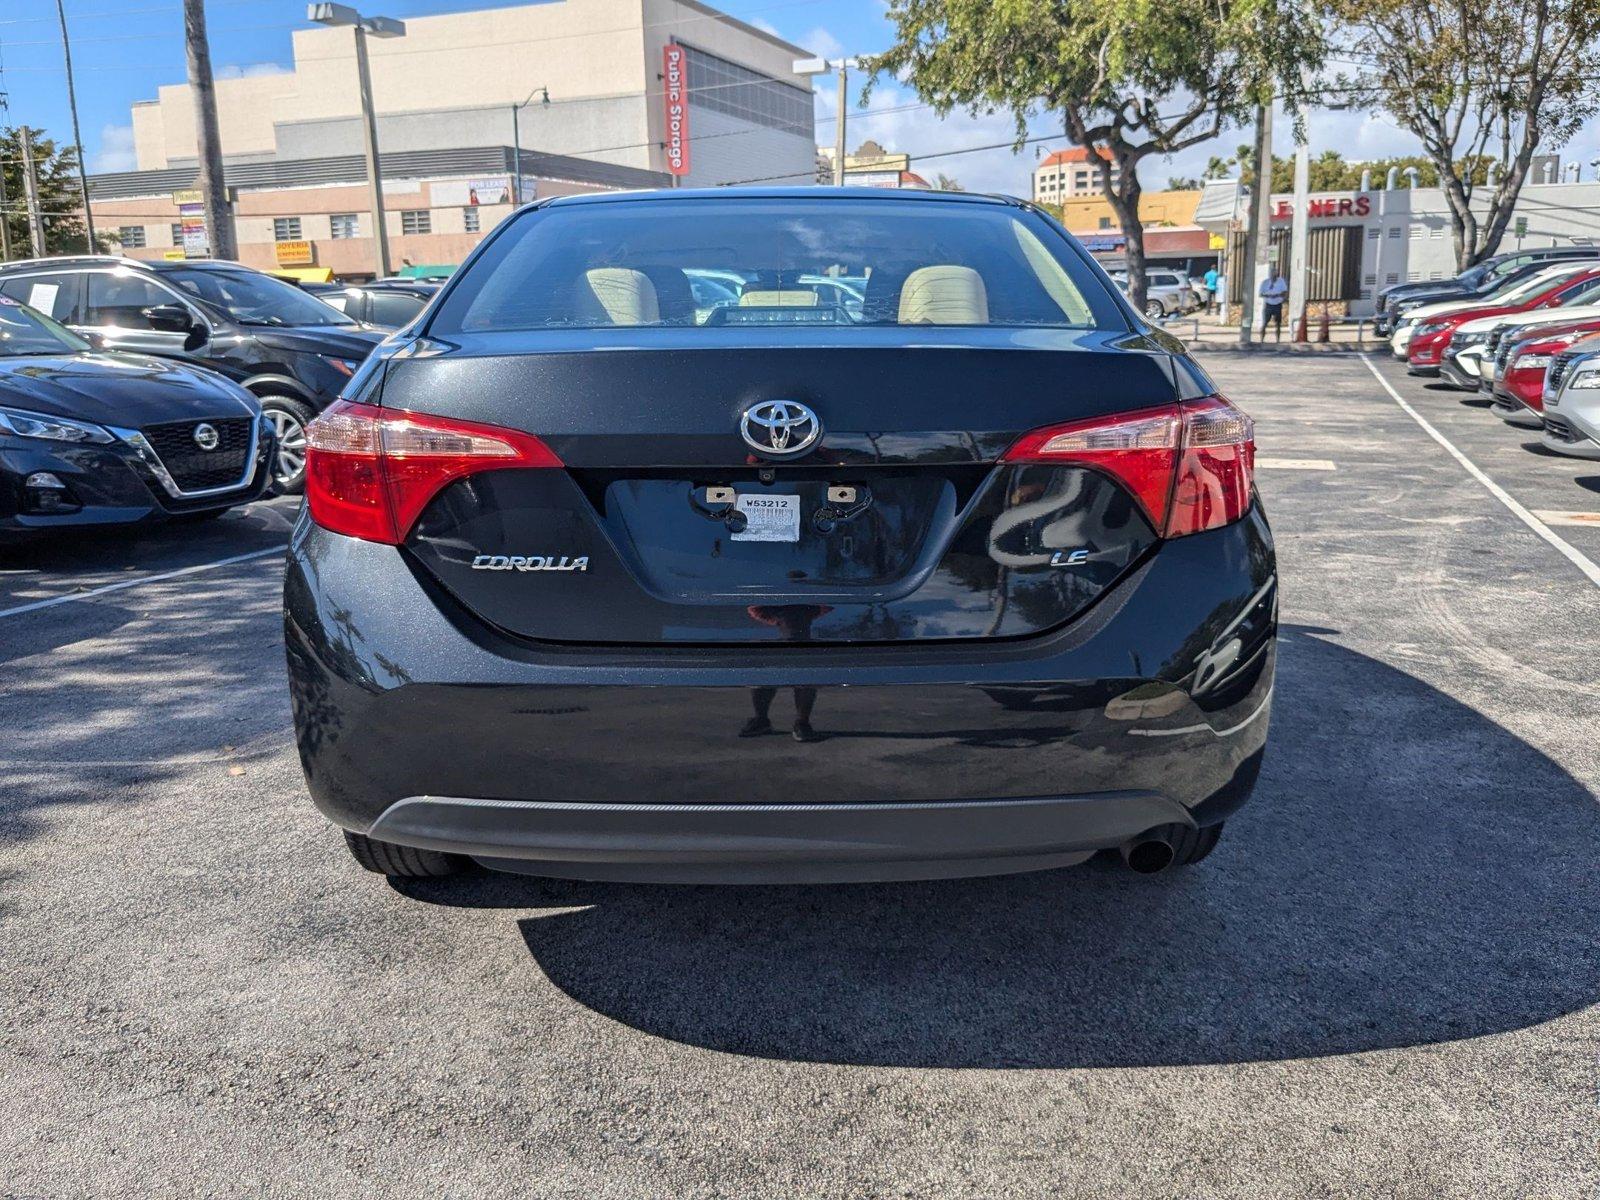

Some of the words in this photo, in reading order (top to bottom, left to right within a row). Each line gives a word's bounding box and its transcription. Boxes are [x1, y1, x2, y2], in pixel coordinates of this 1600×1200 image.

[668, 51, 681, 102] Public
[668, 106, 682, 168] Storage
[470, 181, 484, 189] FOR
[746, 500, 788, 508] W53212
[471, 555, 589, 572] COROLLA
[1050, 549, 1089, 567] LE
